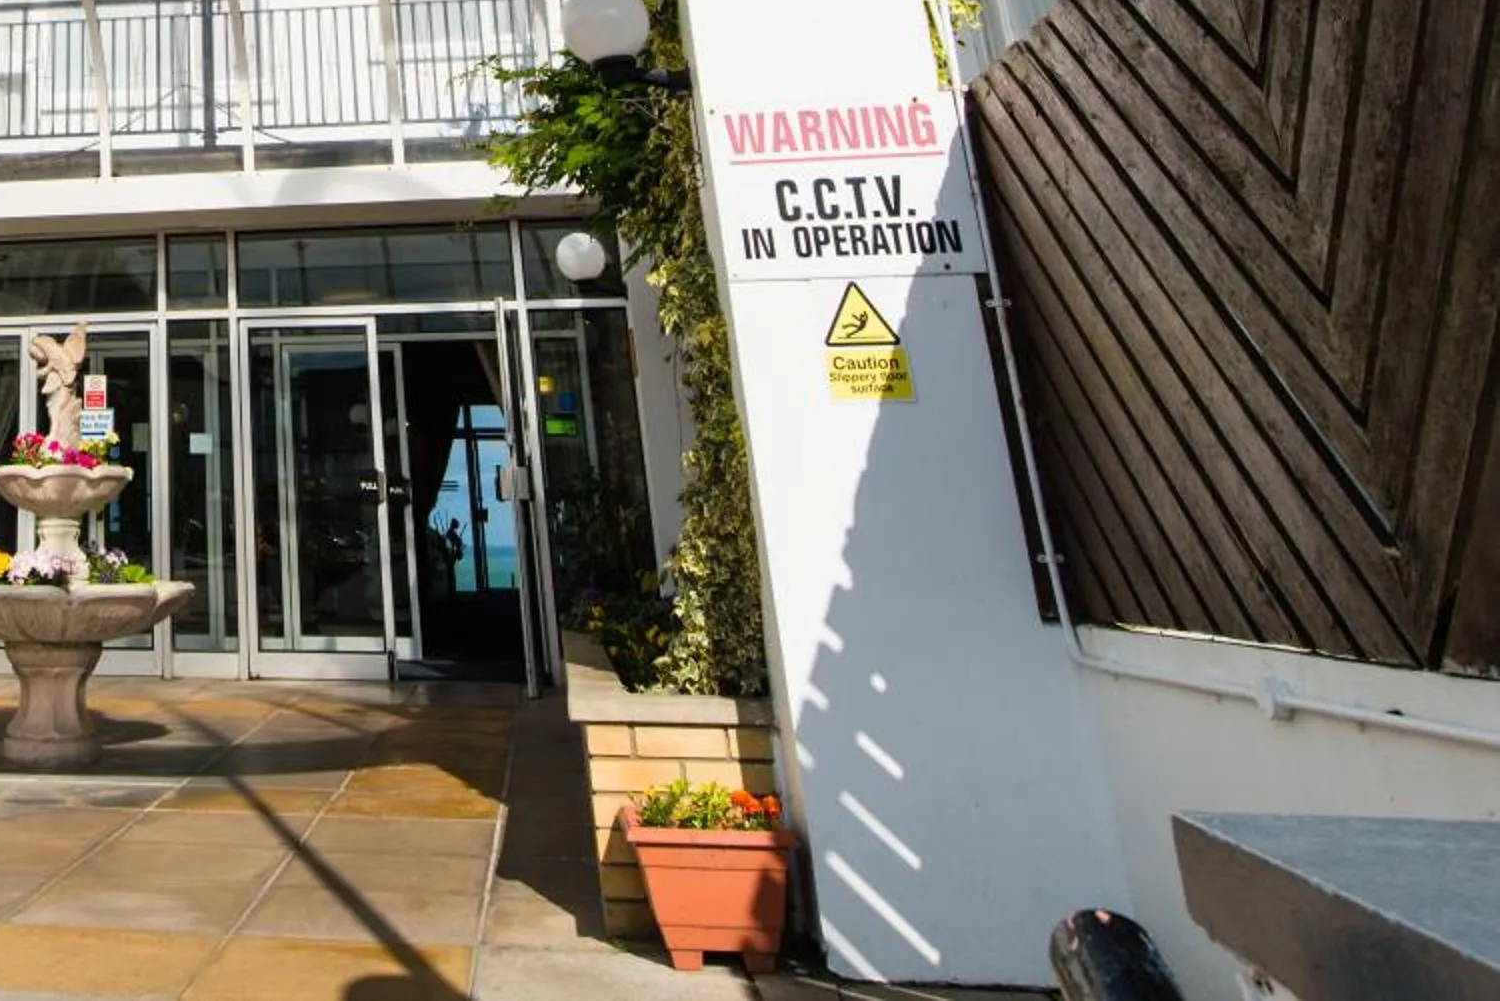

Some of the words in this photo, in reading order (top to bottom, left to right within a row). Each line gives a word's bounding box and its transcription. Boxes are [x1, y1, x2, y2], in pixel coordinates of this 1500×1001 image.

[724, 102, 938, 155] WARNING
[775, 175, 916, 222] C.C.T.V.
[741, 228, 777, 260] IN
[793, 219, 963, 258] OPERATION
[832, 356, 899, 371] Caution
